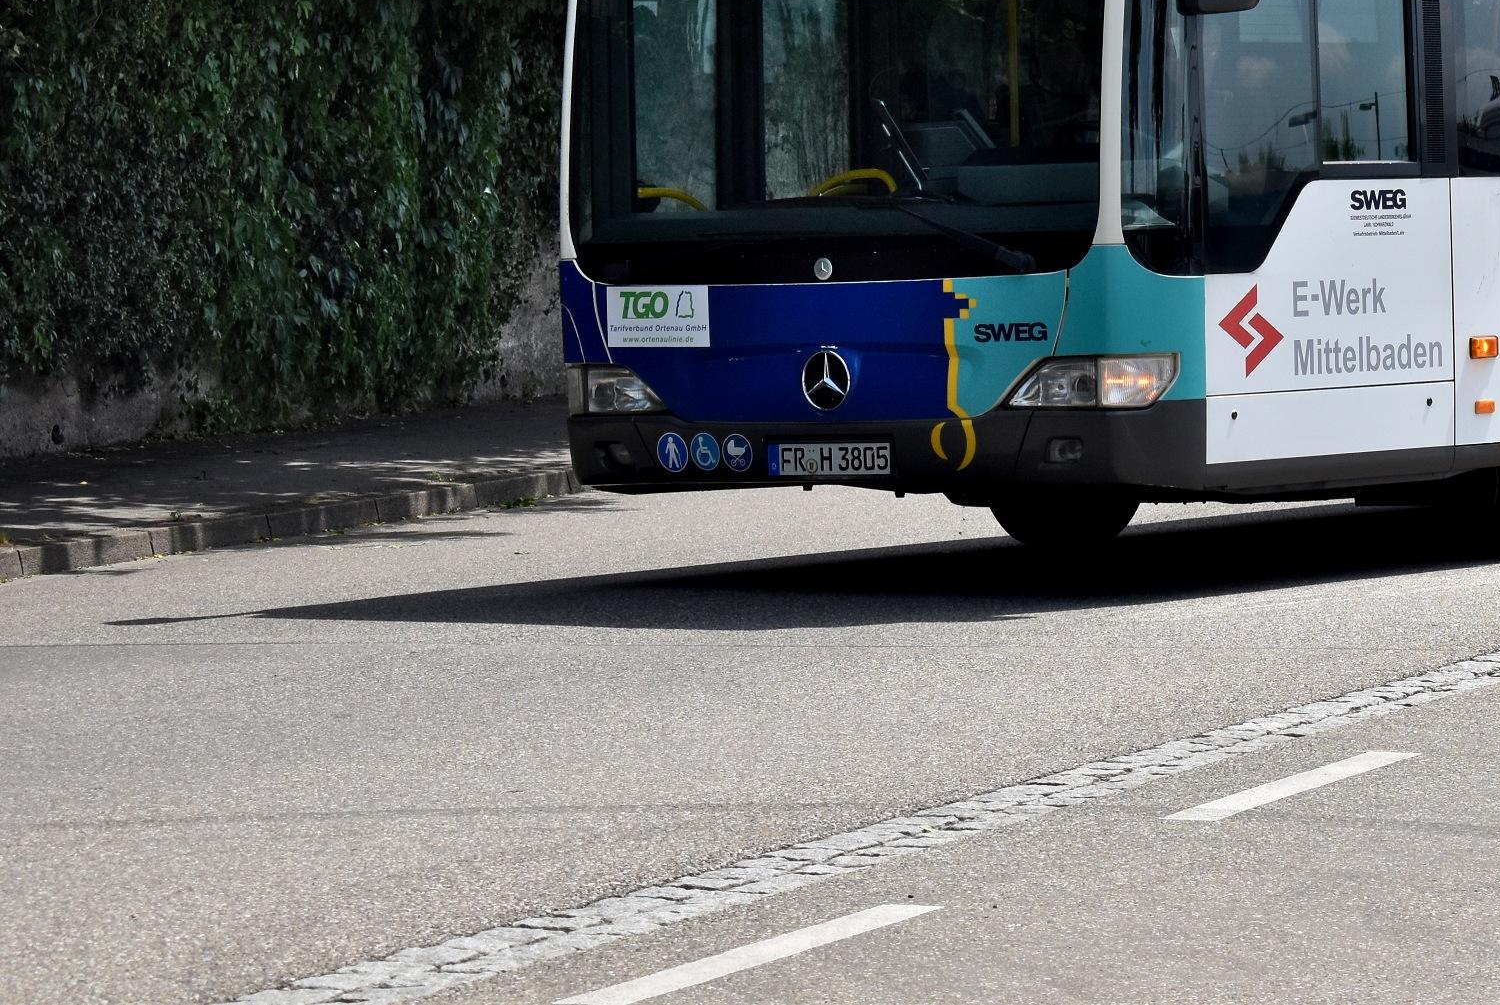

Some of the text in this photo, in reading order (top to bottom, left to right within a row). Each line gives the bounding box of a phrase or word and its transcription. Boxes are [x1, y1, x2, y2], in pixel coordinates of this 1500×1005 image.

[1350, 189, 1407, 210] SWEG
[620, 291, 669, 319] TGO
[1292, 278, 1387, 318] E-Werk
[609, 324, 707, 332] Tarifverbund Ortenau GmbH
[622, 335, 694, 343] www.ortenaulinie.de
[973, 321, 1048, 343] SWEG
[1293, 334, 1443, 376] Mittelbaden
[781, 446, 889, 472] FR H 3805
